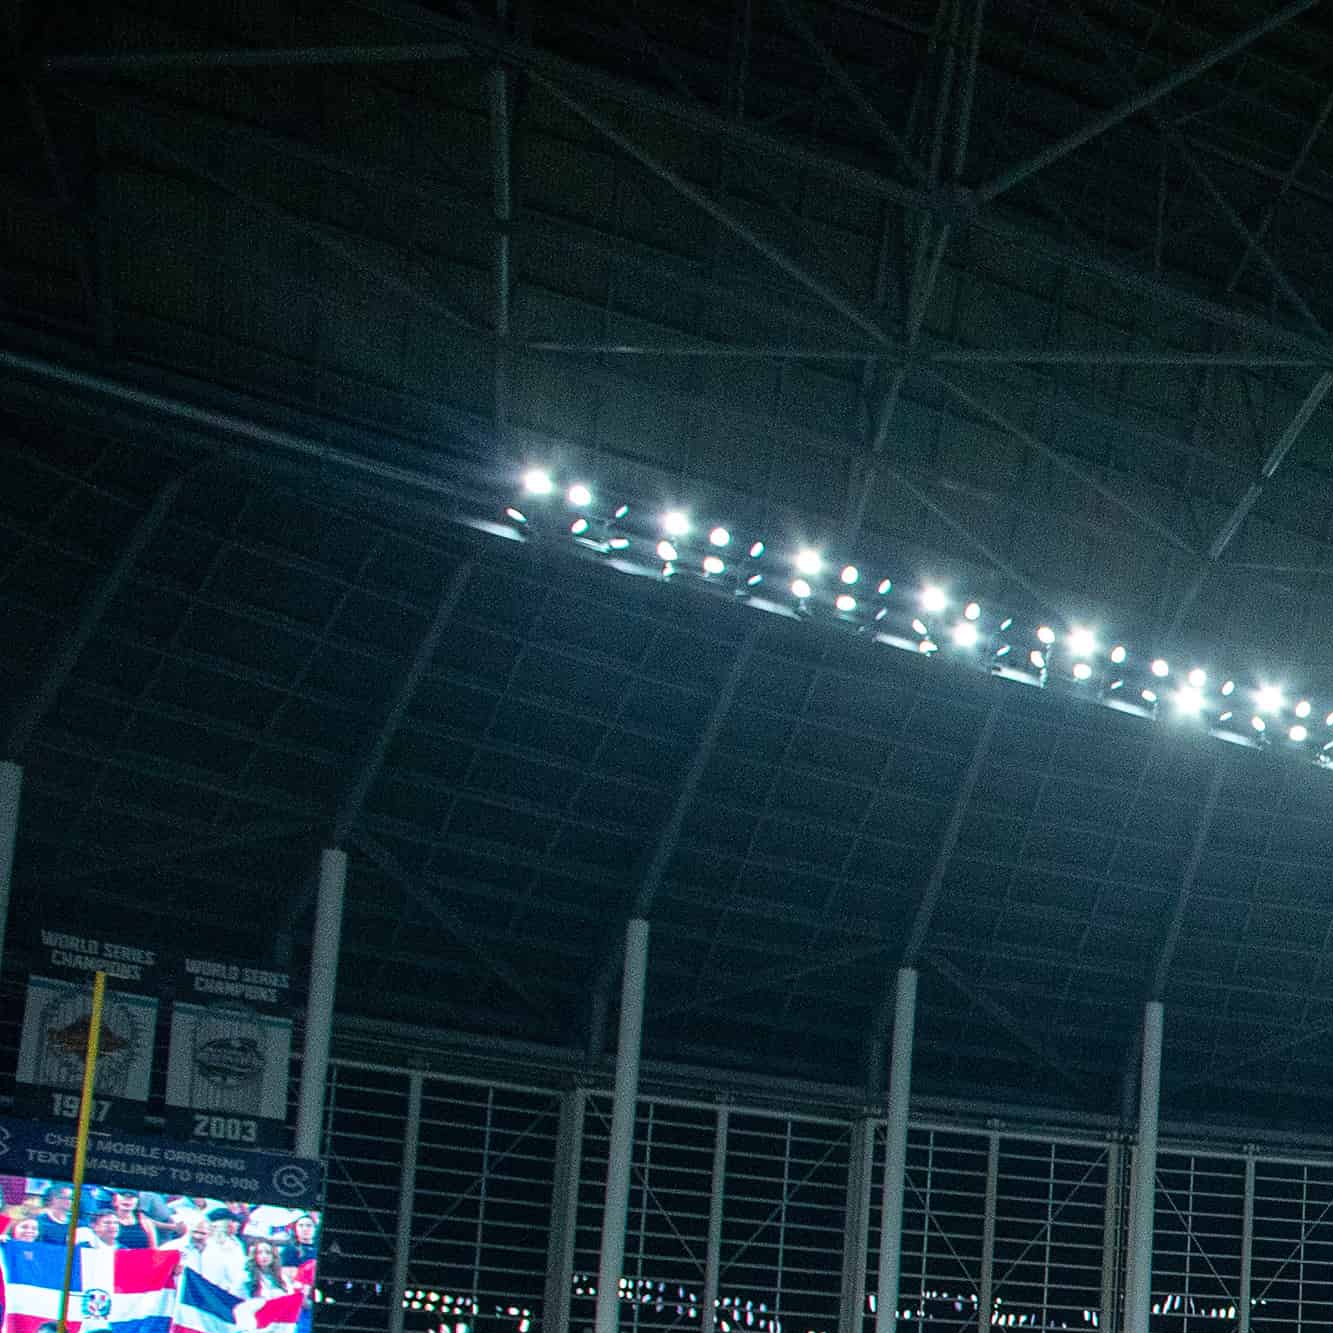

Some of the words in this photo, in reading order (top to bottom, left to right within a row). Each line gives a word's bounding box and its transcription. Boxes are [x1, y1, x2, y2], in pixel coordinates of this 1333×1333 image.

[52, 1093, 112, 1122] 197
[193, 1115, 258, 1141] 2003
[26, 1148, 72, 1166] TEXT
[97, 1140, 161, 1160] MOBILE
